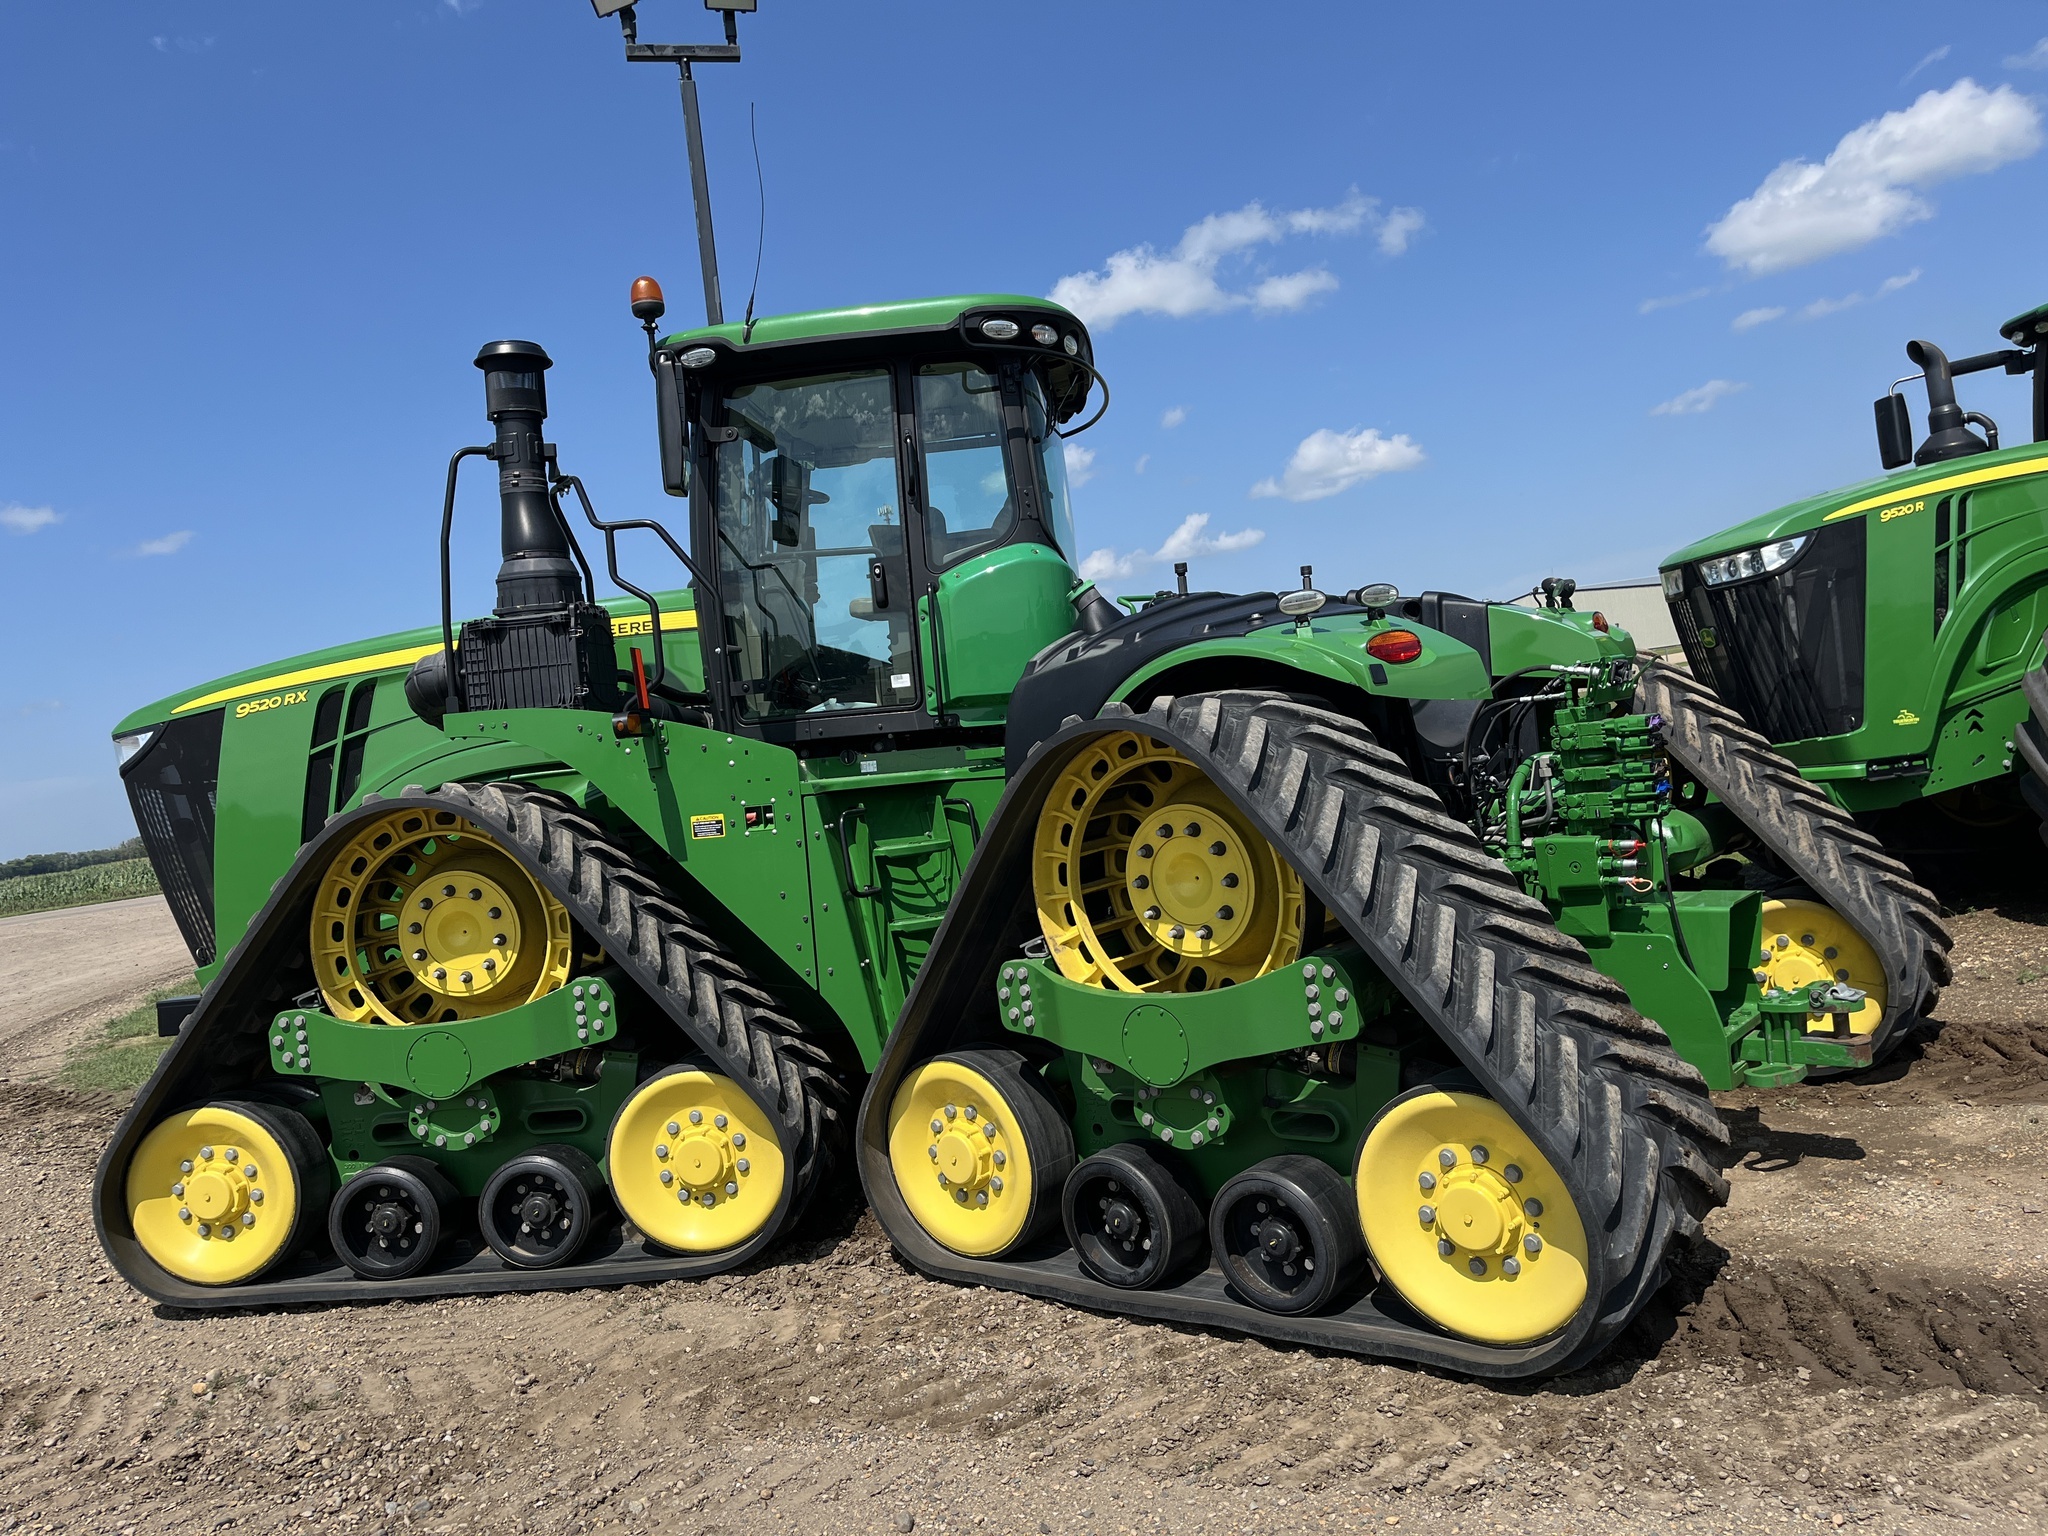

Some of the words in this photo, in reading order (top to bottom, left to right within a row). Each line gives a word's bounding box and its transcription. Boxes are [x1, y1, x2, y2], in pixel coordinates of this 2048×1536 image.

[1880, 503, 1914, 523] 9520
[1915, 501, 1925, 512] R
[610, 620, 653, 635] EERE
[235, 696, 282, 719] 9520
[283, 689, 310, 706] RX
